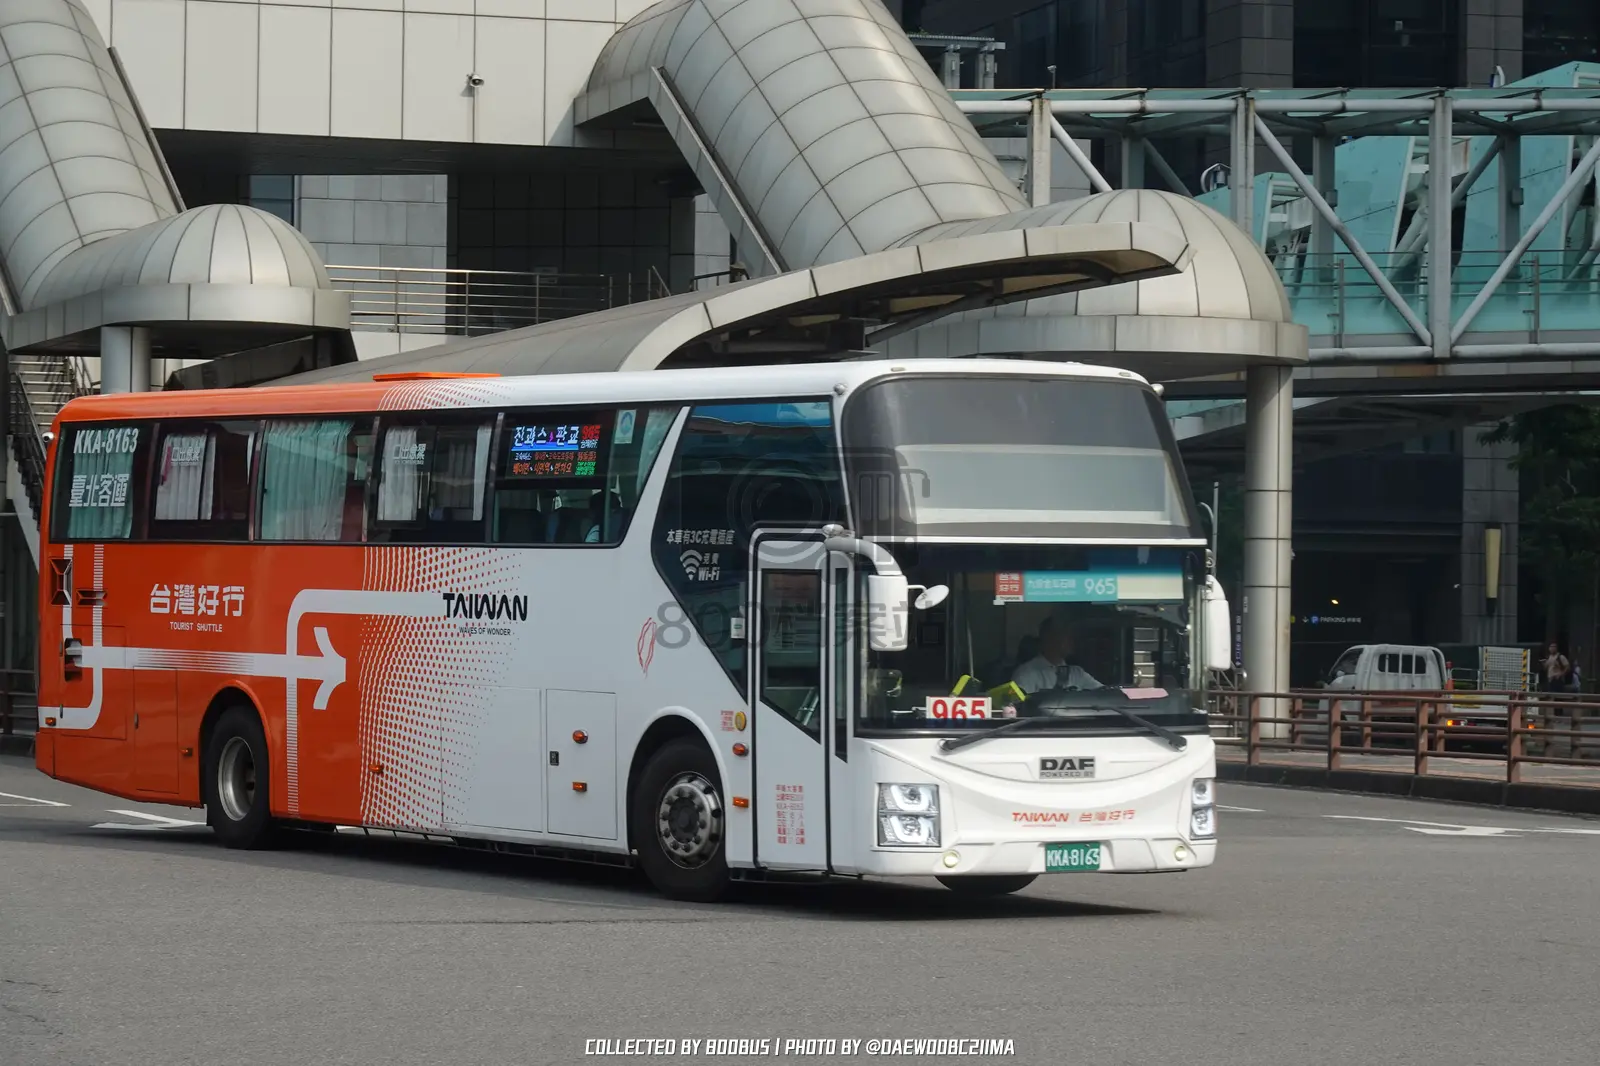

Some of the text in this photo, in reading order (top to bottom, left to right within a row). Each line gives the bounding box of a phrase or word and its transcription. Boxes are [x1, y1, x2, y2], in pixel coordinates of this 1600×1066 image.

[73, 428, 139, 454] KKA-8163
[69, 473, 130, 508] 臺北客運
[698, 566, 720, 581] Wi-Fi
[1084, 578, 1116, 595] 965
[150, 583, 245, 617] 台灣好行
[443, 592, 528, 622] TAIWAN
[169, 621, 223, 633] TOURIST SHUTTLE
[459, 626, 511, 636] WAVES OF WONDER
[932, 699, 985, 719] 965
[1041, 758, 1094, 771] DAF
[1012, 812, 1070, 823] TAIWAN
[1047, 848, 1100, 867] KKA-8163
